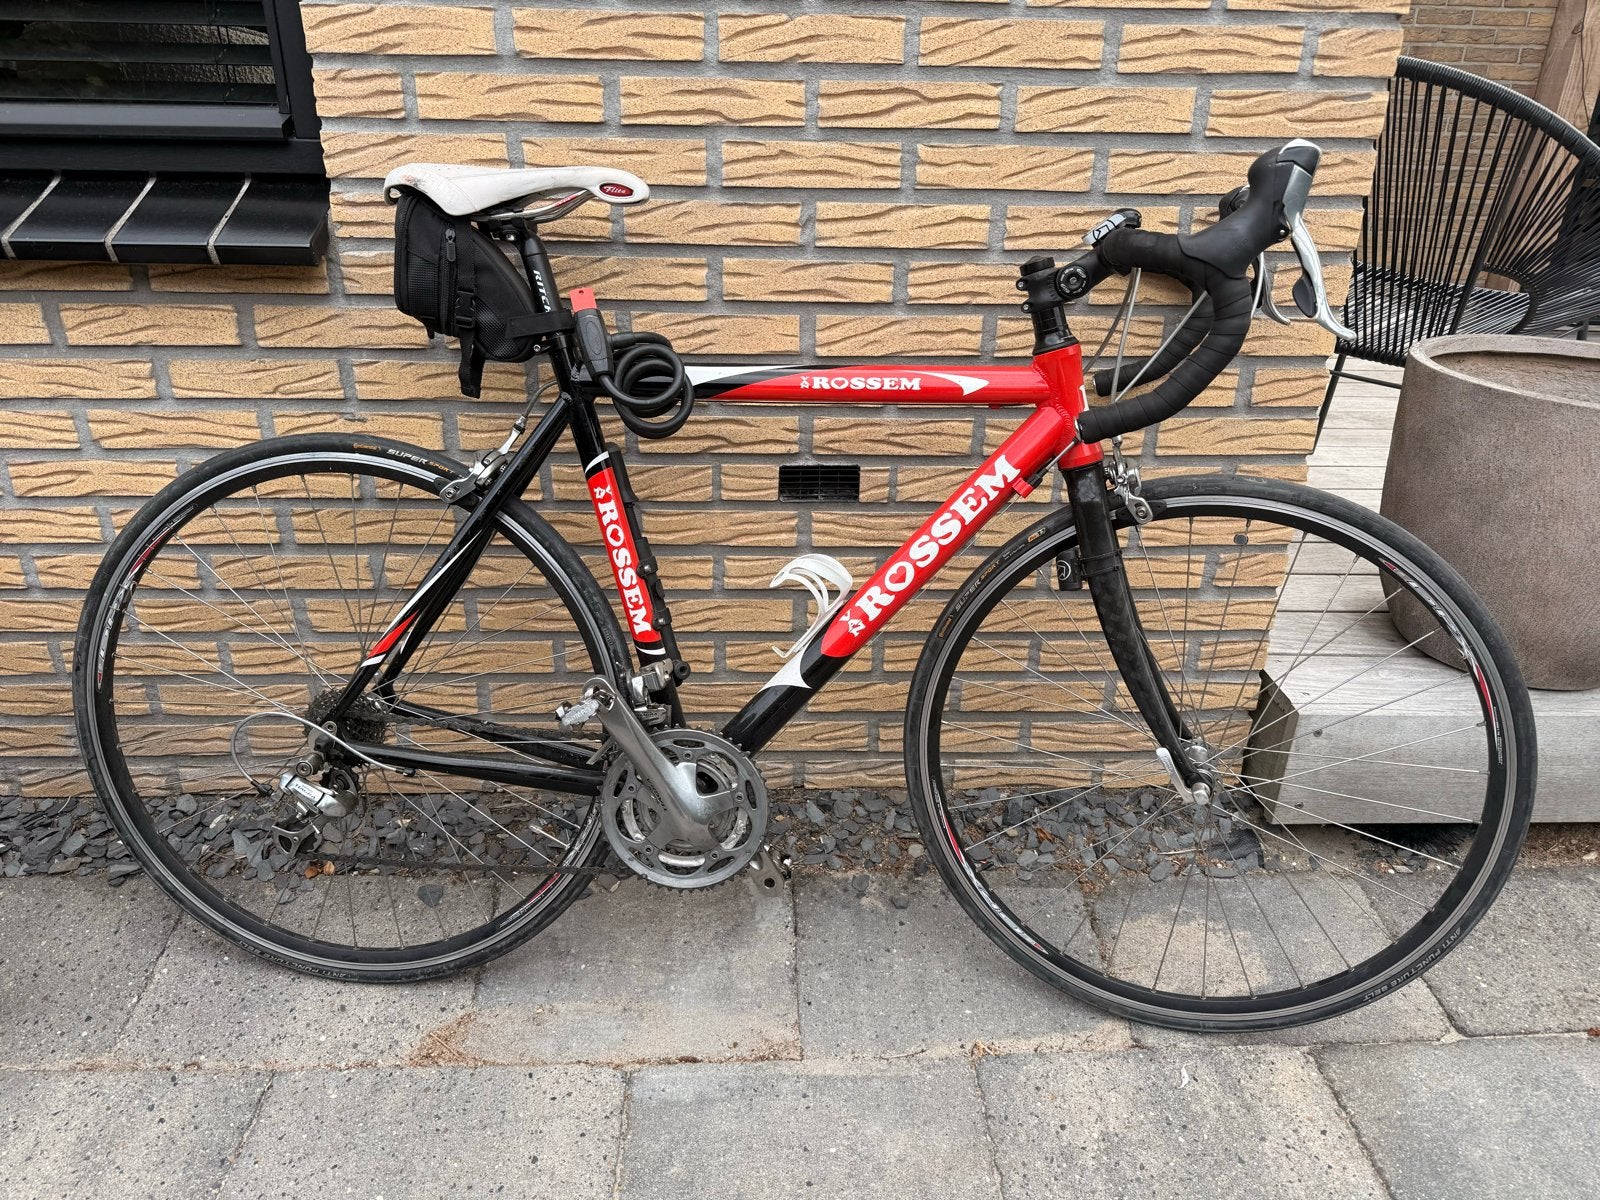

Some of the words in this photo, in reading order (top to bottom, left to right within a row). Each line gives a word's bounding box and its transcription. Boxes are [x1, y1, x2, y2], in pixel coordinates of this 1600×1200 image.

[603, 186, 626, 194] Flite
[812, 376, 922, 390] ROSSEM
[386, 448, 428, 465] SUPER
[428, 461, 455, 474] SPORT
[855, 454, 1021, 622] ROSSEM
[598, 499, 652, 635] ROSSEM
[955, 579, 981, 612] SUPER
[980, 560, 1000, 581] SPORT
[1442, 927, 1461, 949] ANTI
[263, 952, 319, 974] PUNCTURE
[322, 969, 346, 978] ANTI
[1390, 948, 1441, 987] PUNCTURE
[1362, 986, 1389, 1002] BELT
